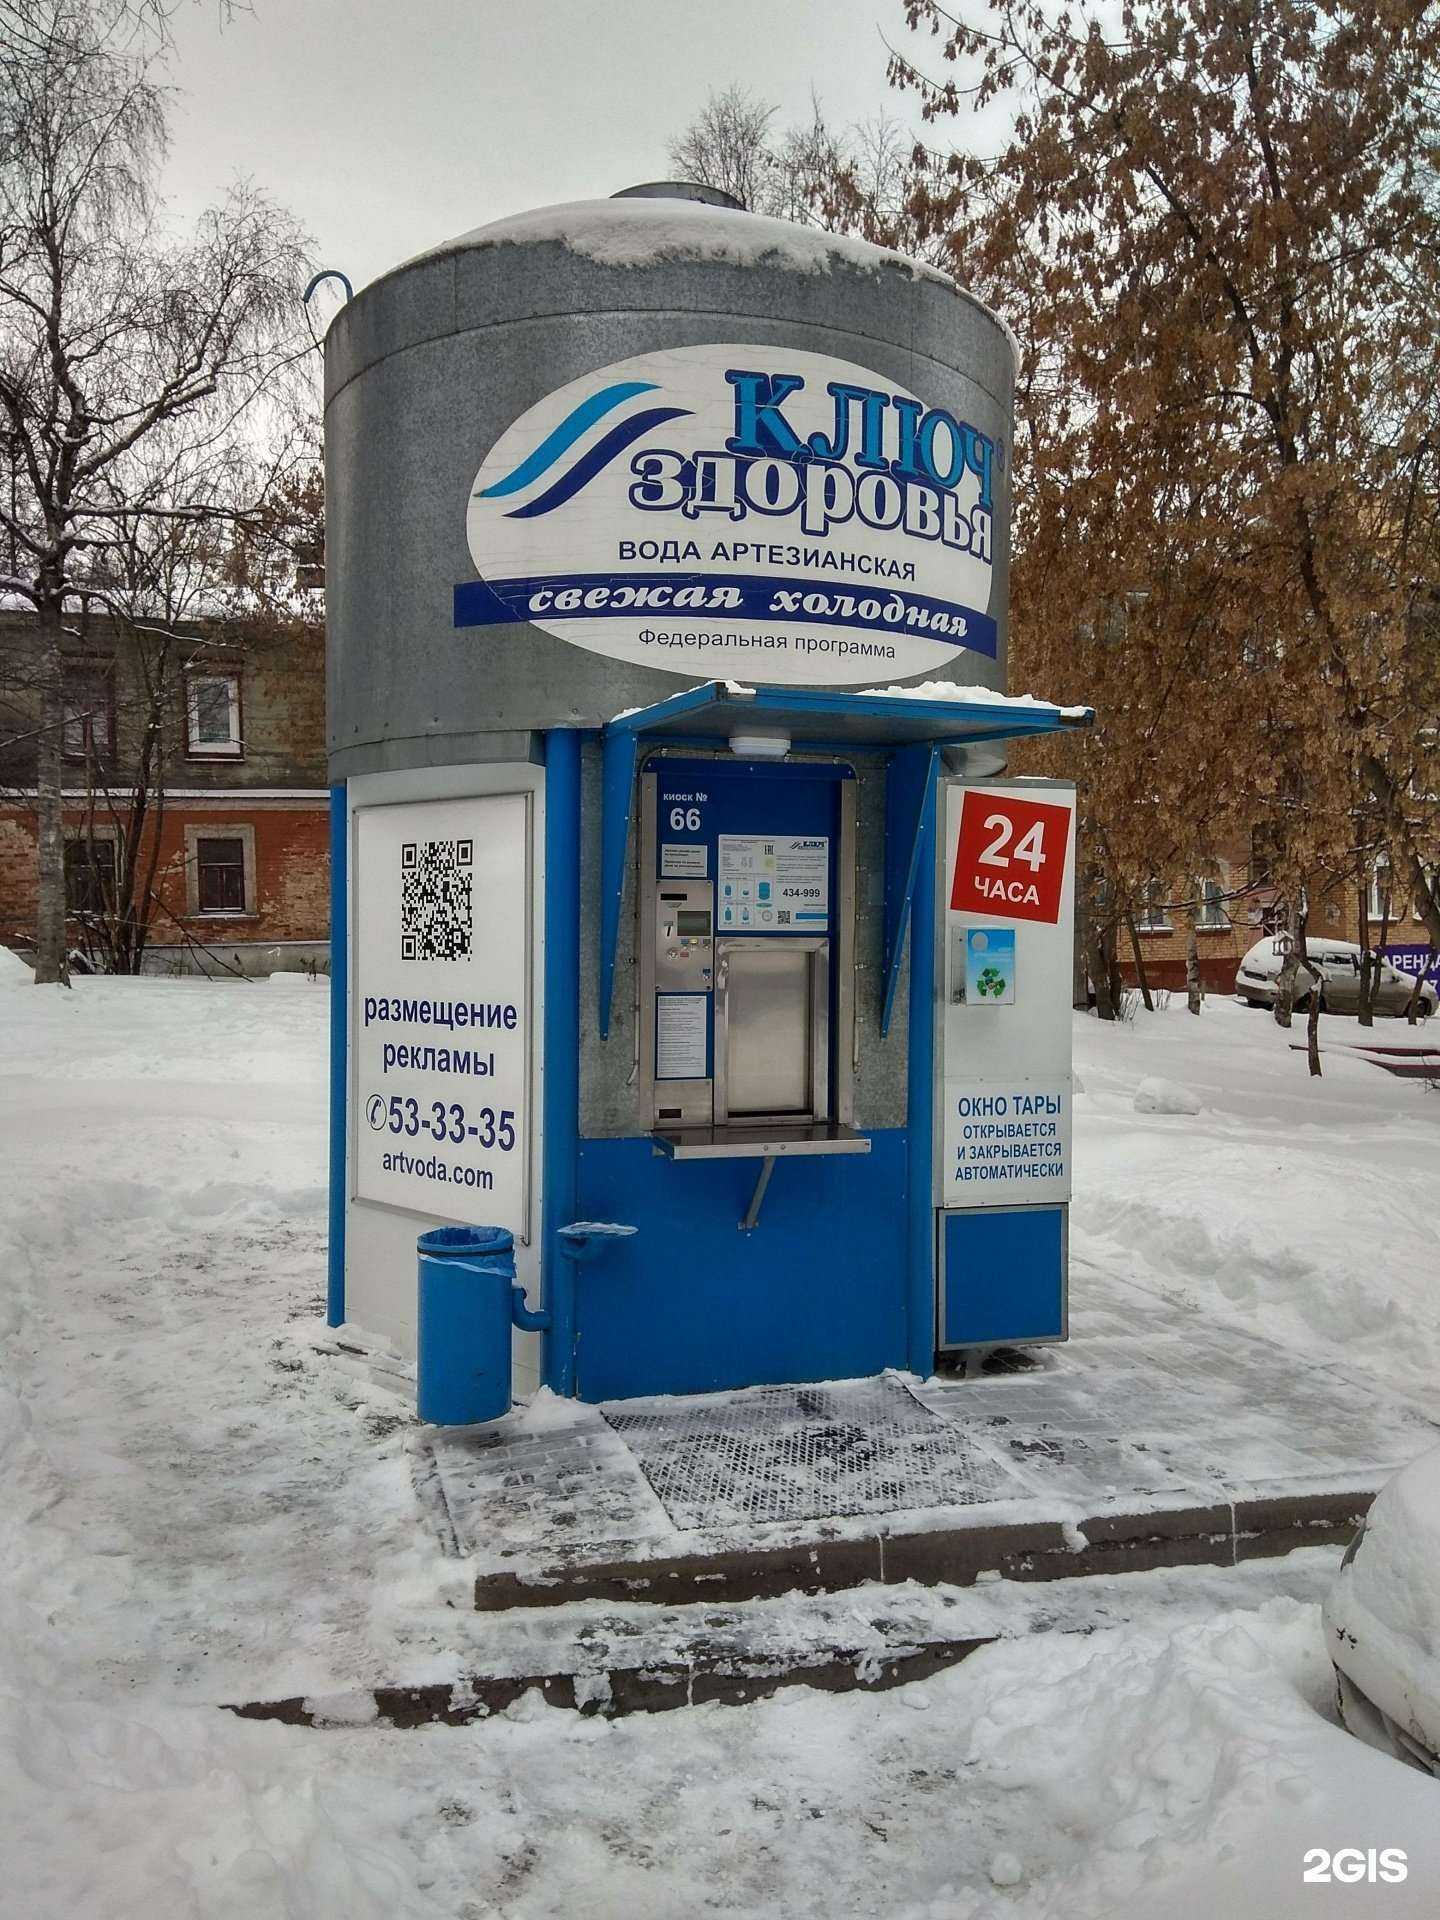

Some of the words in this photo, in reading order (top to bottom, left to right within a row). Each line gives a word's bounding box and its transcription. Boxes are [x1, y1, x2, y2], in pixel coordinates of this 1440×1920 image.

[724, 369, 994, 508] КЛЮЧ
[618, 540, 702, 562] ВОДА
[711, 542, 916, 582] АРТЕЗИАНСКАЯ
[528, 582, 743, 613] свежая
[769, 589, 969, 638] холодная
[638, 629, 788, 653] Федеральная
[793, 636, 896, 662] программа
[669, 808, 701, 831] 66
[977, 813, 1047, 873] 24
[782, 888, 821, 898] 434-999
[973, 874, 1040, 906] ЧАСА
[363, 995, 518, 1031] размещение
[383, 1042, 495, 1077] рекламы
[958, 1096, 1008, 1118] ОКНО
[1012, 1094, 1061, 1117] ТАРЫ
[388, 1096, 516, 1152] 53-33-35
[962, 1122, 1056, 1140] ОТКРЫВАЕТСЯ
[957, 1144, 967, 1160] И
[969, 1142, 1062, 1160] ЗАКРЫВАЕТСЯ
[382, 1150, 494, 1191] artvoda.com
[954, 1163, 1063, 1182] АВТОМАТИЧЕСКИ
